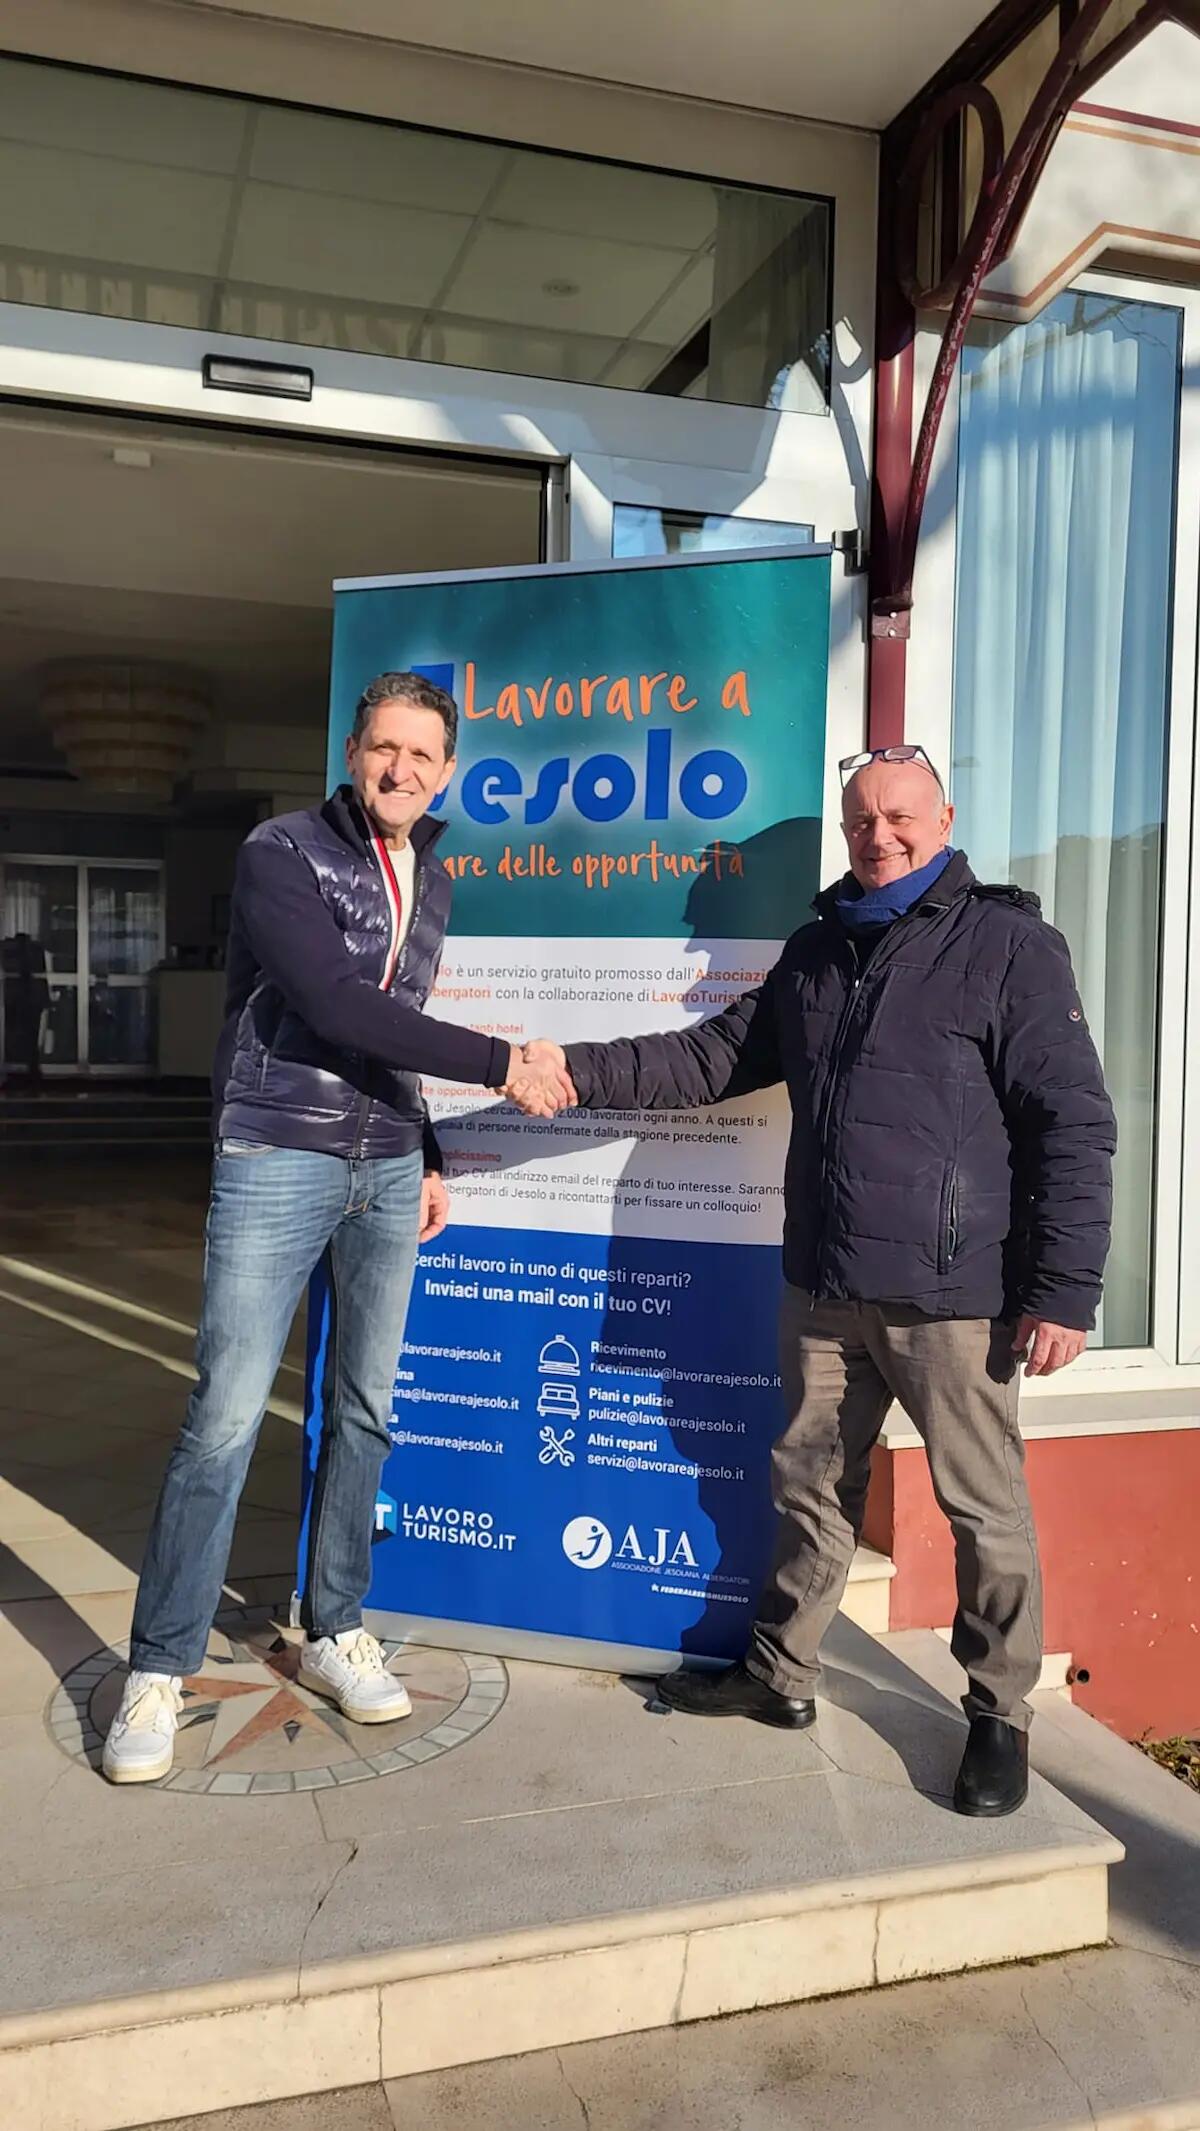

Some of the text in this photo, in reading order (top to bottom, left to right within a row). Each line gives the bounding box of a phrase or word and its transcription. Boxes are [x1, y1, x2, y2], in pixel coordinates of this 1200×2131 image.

[464, 661, 751, 727] Lavorare a
[443, 854, 488, 880] are
[498, 843, 562, 882] delle
[467, 967, 483, 978] un
[487, 965, 537, 979] servizio
[541, 966, 591, 982] gratuito
[595, 968, 662, 983] promosso
[432, 986, 741, 1004] bergatori con la collaborazione di LavoroTuris
[484, 1106, 526, 1117] cercan
[590, 1110, 641, 1123] lavoratori
[643, 1112, 668, 1125] ogni
[705, 1114, 715, 1125] A
[718, 1114, 754, 1128] questi
[757, 1115, 768, 1127] si
[465, 1120, 476, 1131] di
[478, 1122, 521, 1135] persone
[523, 1123, 591, 1138] riconfermate
[594, 1126, 619, 1138] dalla
[622, 1128, 669, 1143] stagione
[673, 1131, 742, 1145] precedente.
[472, 1168, 489, 1179] CV
[551, 1173, 579, 1184] email
[583, 1174, 599, 1186] del
[601, 1177, 641, 1191] reparto
[644, 1177, 654, 1189] di
[657, 1180, 675, 1191] tuo
[678, 1181, 735, 1194] interesse.
[446, 1184, 761, 1214] lbergatori di Jesolo a ricontattarti per fissare un colloquio!
[459, 1254, 506, 1273] lavoro
[510, 1258, 524, 1275] in
[527, 1263, 557, 1278] uno
[560, 1260, 575, 1279] di
[578, 1263, 627, 1284] questi
[630, 1270, 692, 1289] reparti?
[425, 1278, 671, 1316] Inviaci una mail con il tuo CV!
[400, 1341, 502, 1363] lavorareajesolo.it
[590, 1341, 667, 1360] Ricevimento
[590, 1361, 782, 1388] ricevimento@lavorareajesolo.it
[588, 1387, 674, 1408] Piani e pulizie
[588, 1407, 746, 1434] pulizie@lavorareajesolo.it
[587, 1433, 658, 1453] Altri reparti
[587, 1454, 744, 1481] servizi@lavorareajesolo.it
[403, 1502, 494, 1530] LAVORO
[402, 1521, 517, 1551] TURISMO.IT
[615, 1524, 700, 1567] AJA
